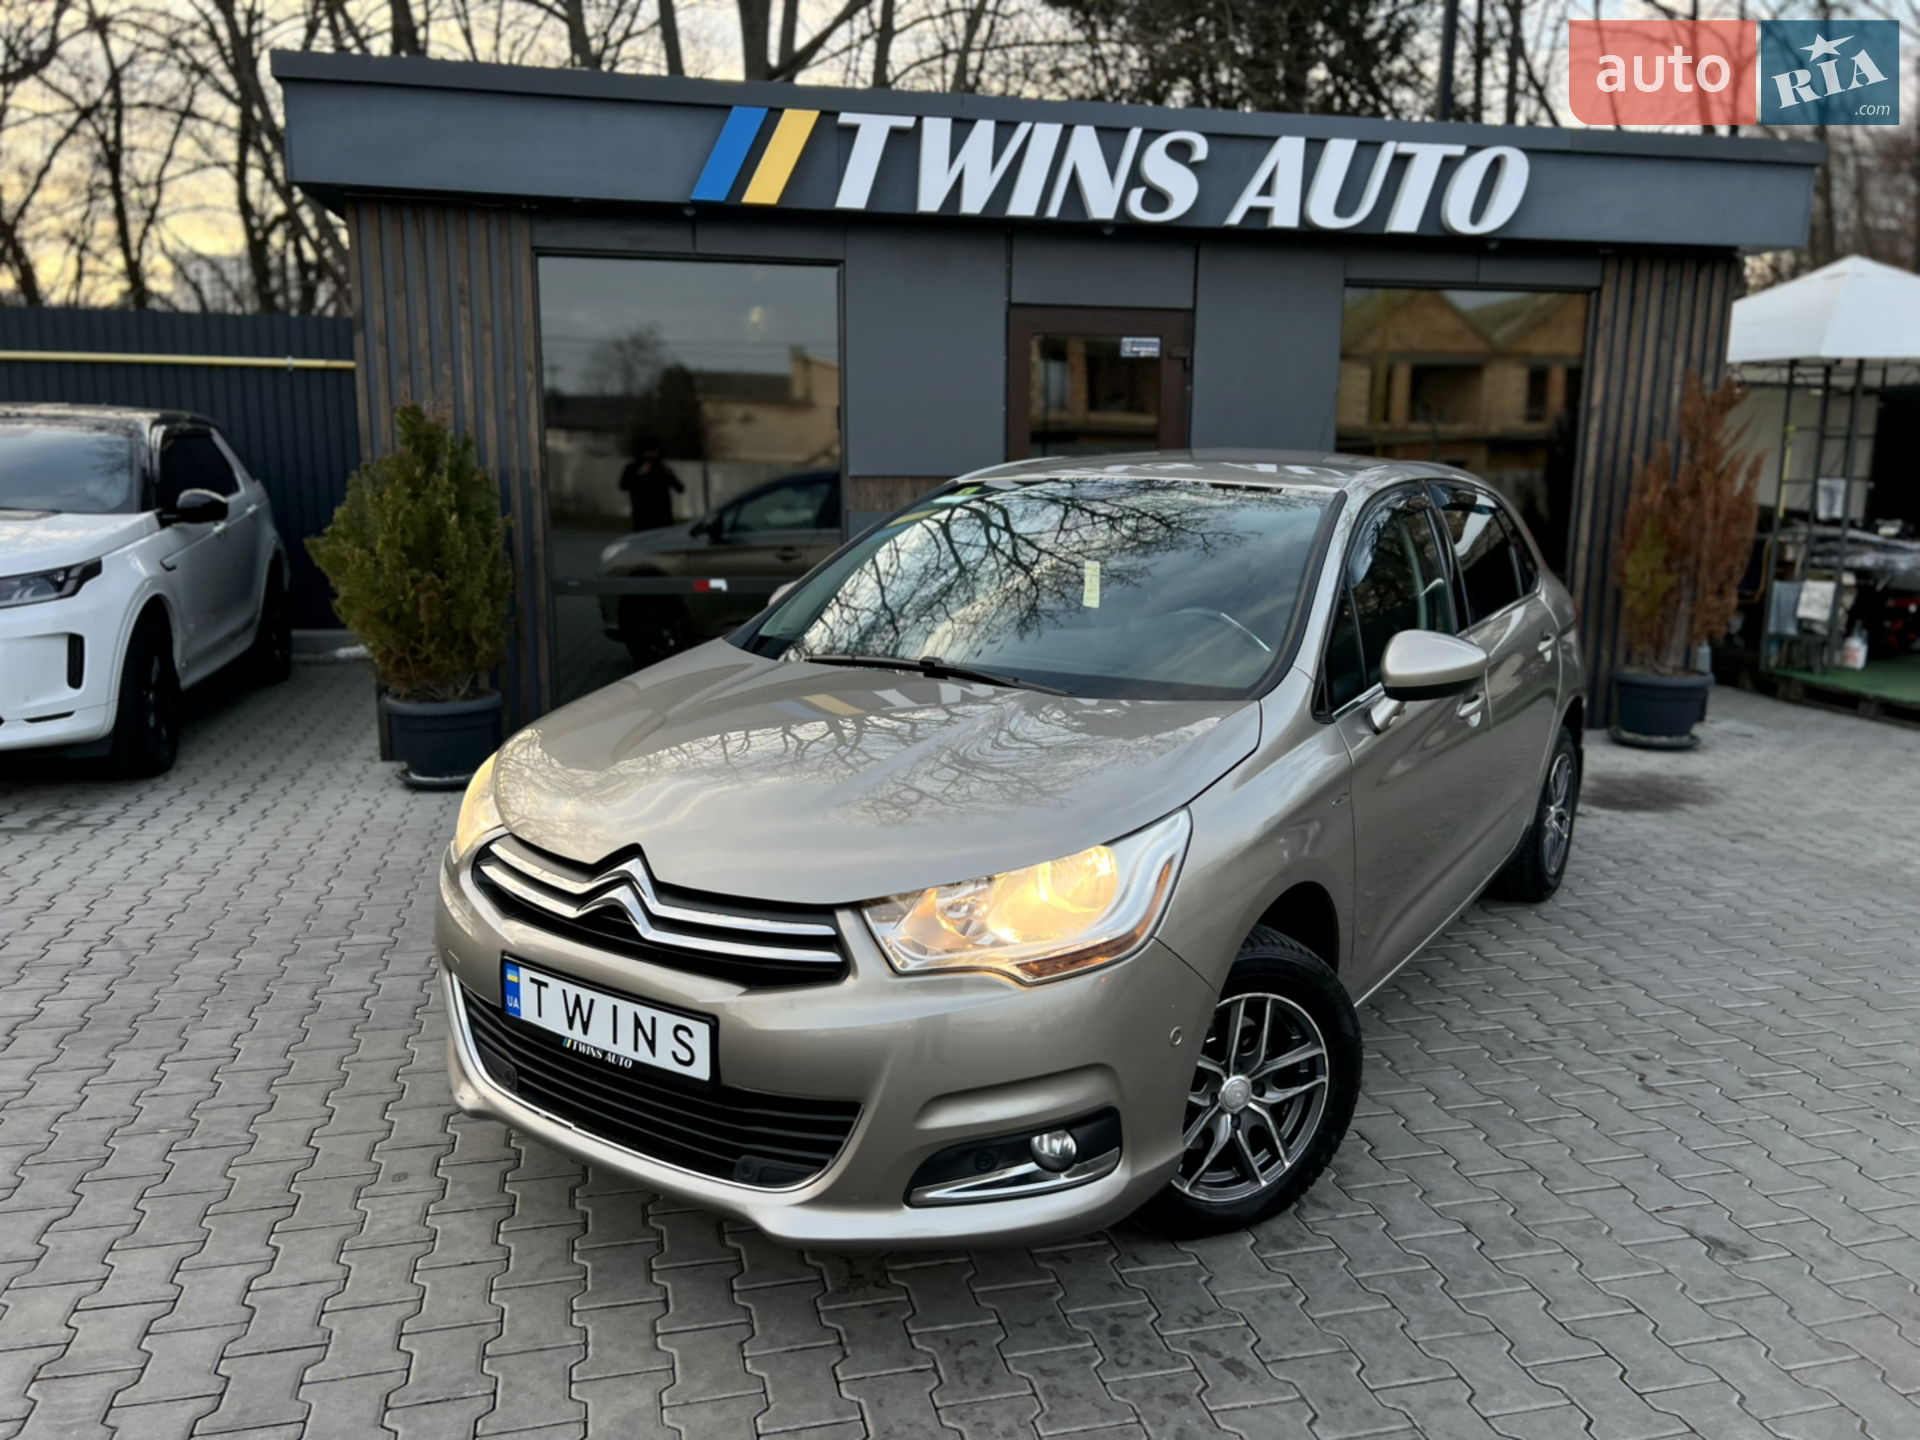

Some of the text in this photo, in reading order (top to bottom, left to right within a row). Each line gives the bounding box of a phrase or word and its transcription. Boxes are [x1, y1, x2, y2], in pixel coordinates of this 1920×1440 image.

[833, 111, 1531, 237] TWINS AUTO
[506, 994, 520, 1010] UA
[571, 1039, 633, 1069] TWINS AUTO
